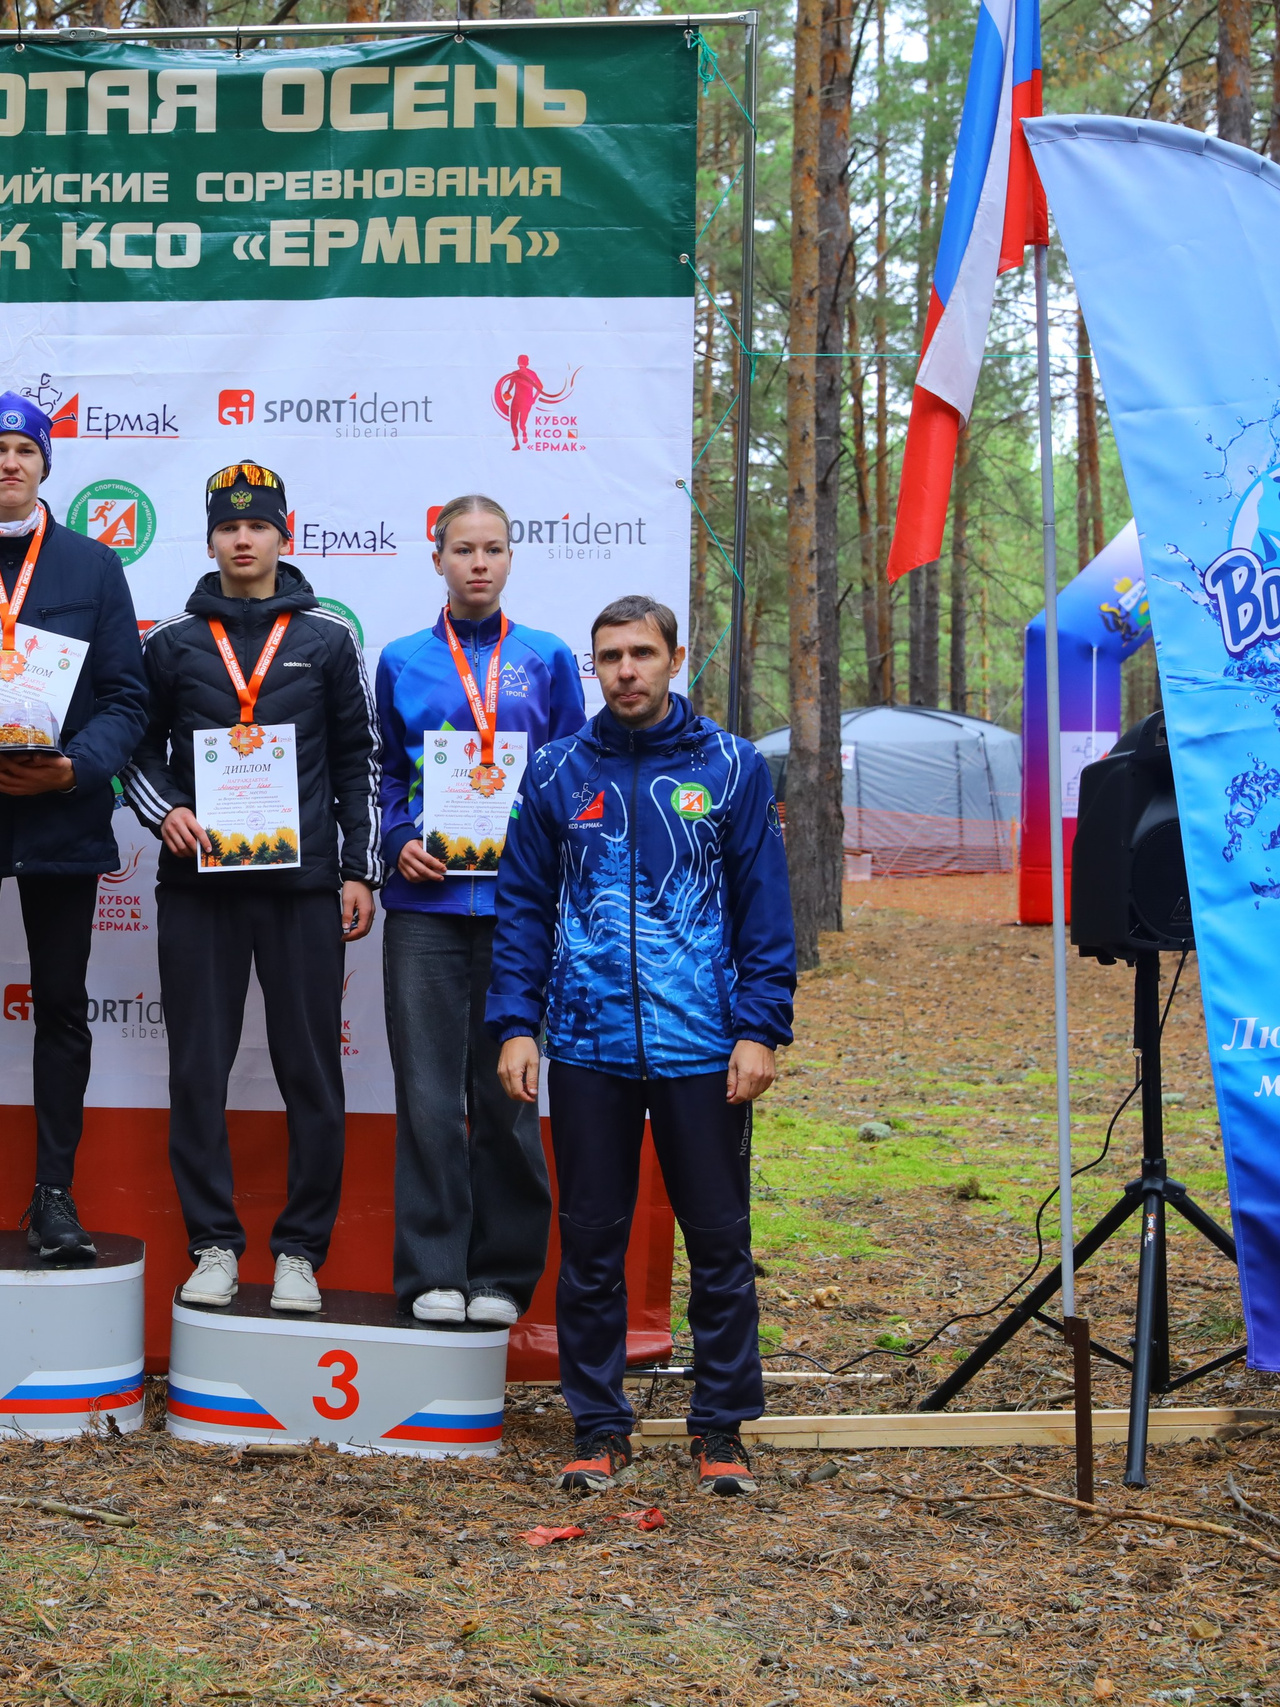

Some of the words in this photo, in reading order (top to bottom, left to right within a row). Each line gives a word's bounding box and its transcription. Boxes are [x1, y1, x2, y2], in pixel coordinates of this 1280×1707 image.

[262, 64, 587, 134] ОСЕНЬ
[196, 166, 562, 202] СОРЕВНОВАНИЯ
[61, 221, 202, 270] КСО
[231, 216, 561, 269] «ЕРМАК»
[263, 391, 433, 424] SPORTident
[85, 403, 180, 440] Ермак
[535, 416, 578, 426] КУБОК
[335, 425, 398, 439] siberia
[535, 429, 563, 439] КСО
[527, 442, 587, 452] «ЕРМАК»
[94, 483, 140, 498] СПОРТИВНОГО
[509, 512, 647, 545] ORTident
[303, 521, 398, 558] Ермак
[548, 546, 611, 560] siberia
[319, 601, 347, 616] ТИВНОГО
[505, 690, 527, 698] ТРОПА
[222, 763, 272, 776] ДИПЛОМ
[98, 895, 141, 906] КУБОК
[98, 908, 125, 918] КСО
[121, 1024, 167, 1039] siber
[312, 1349, 360, 1421] 3
